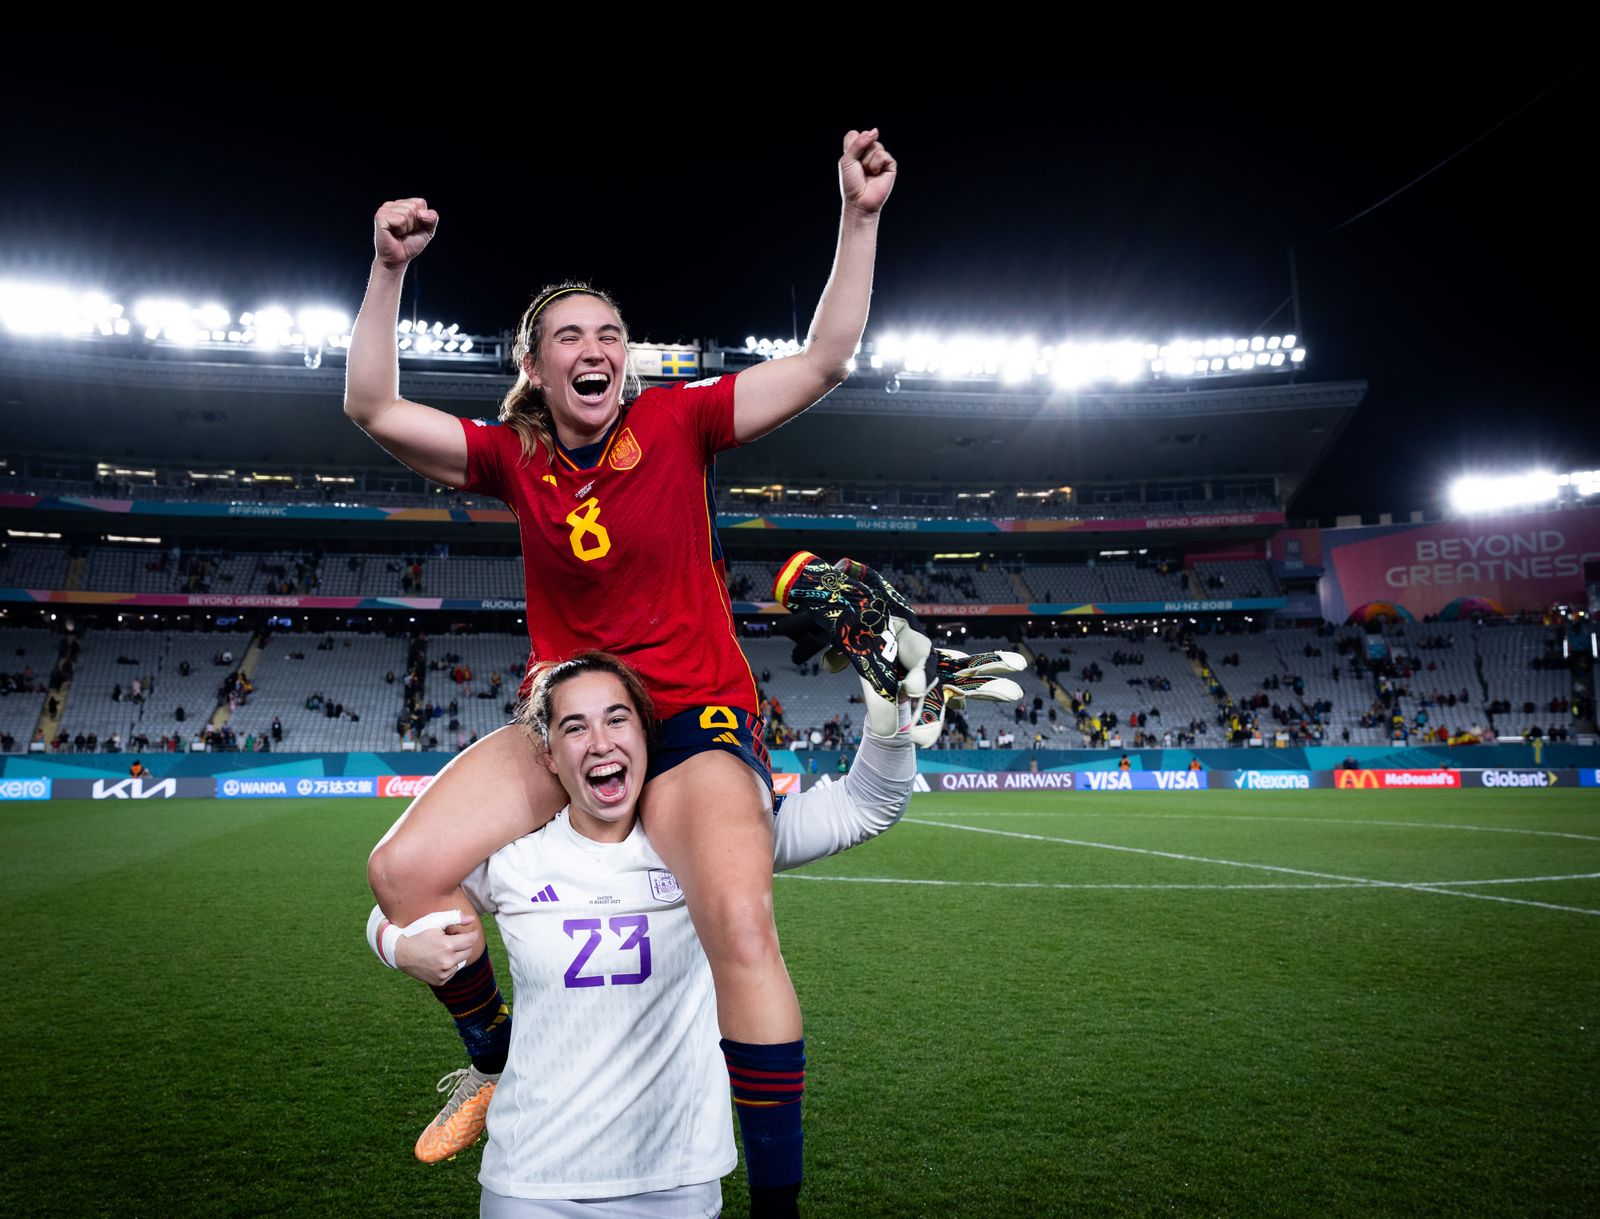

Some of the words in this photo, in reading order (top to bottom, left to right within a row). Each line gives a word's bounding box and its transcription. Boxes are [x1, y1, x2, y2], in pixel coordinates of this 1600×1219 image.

[566, 497, 611, 561] 8
[1416, 530, 1565, 561] BEYOND
[188, 595, 232, 606] BEYOND
[933, 605, 965, 616] WORLD
[967, 605, 989, 616] CUP
[942, 774, 998, 790] QATAR
[1004, 773, 1073, 789] AIRWAYS
[1084, 771, 1132, 790] VISA
[1152, 771, 1200, 789] VISA
[1248, 771, 1310, 789] Rexona
[1385, 773, 1455, 785] McDonald's
[1481, 769, 1548, 787] Globant
[92, 778, 177, 799] KIA
[240, 781, 287, 794] WANDA
[563, 915, 651, 988] 23
